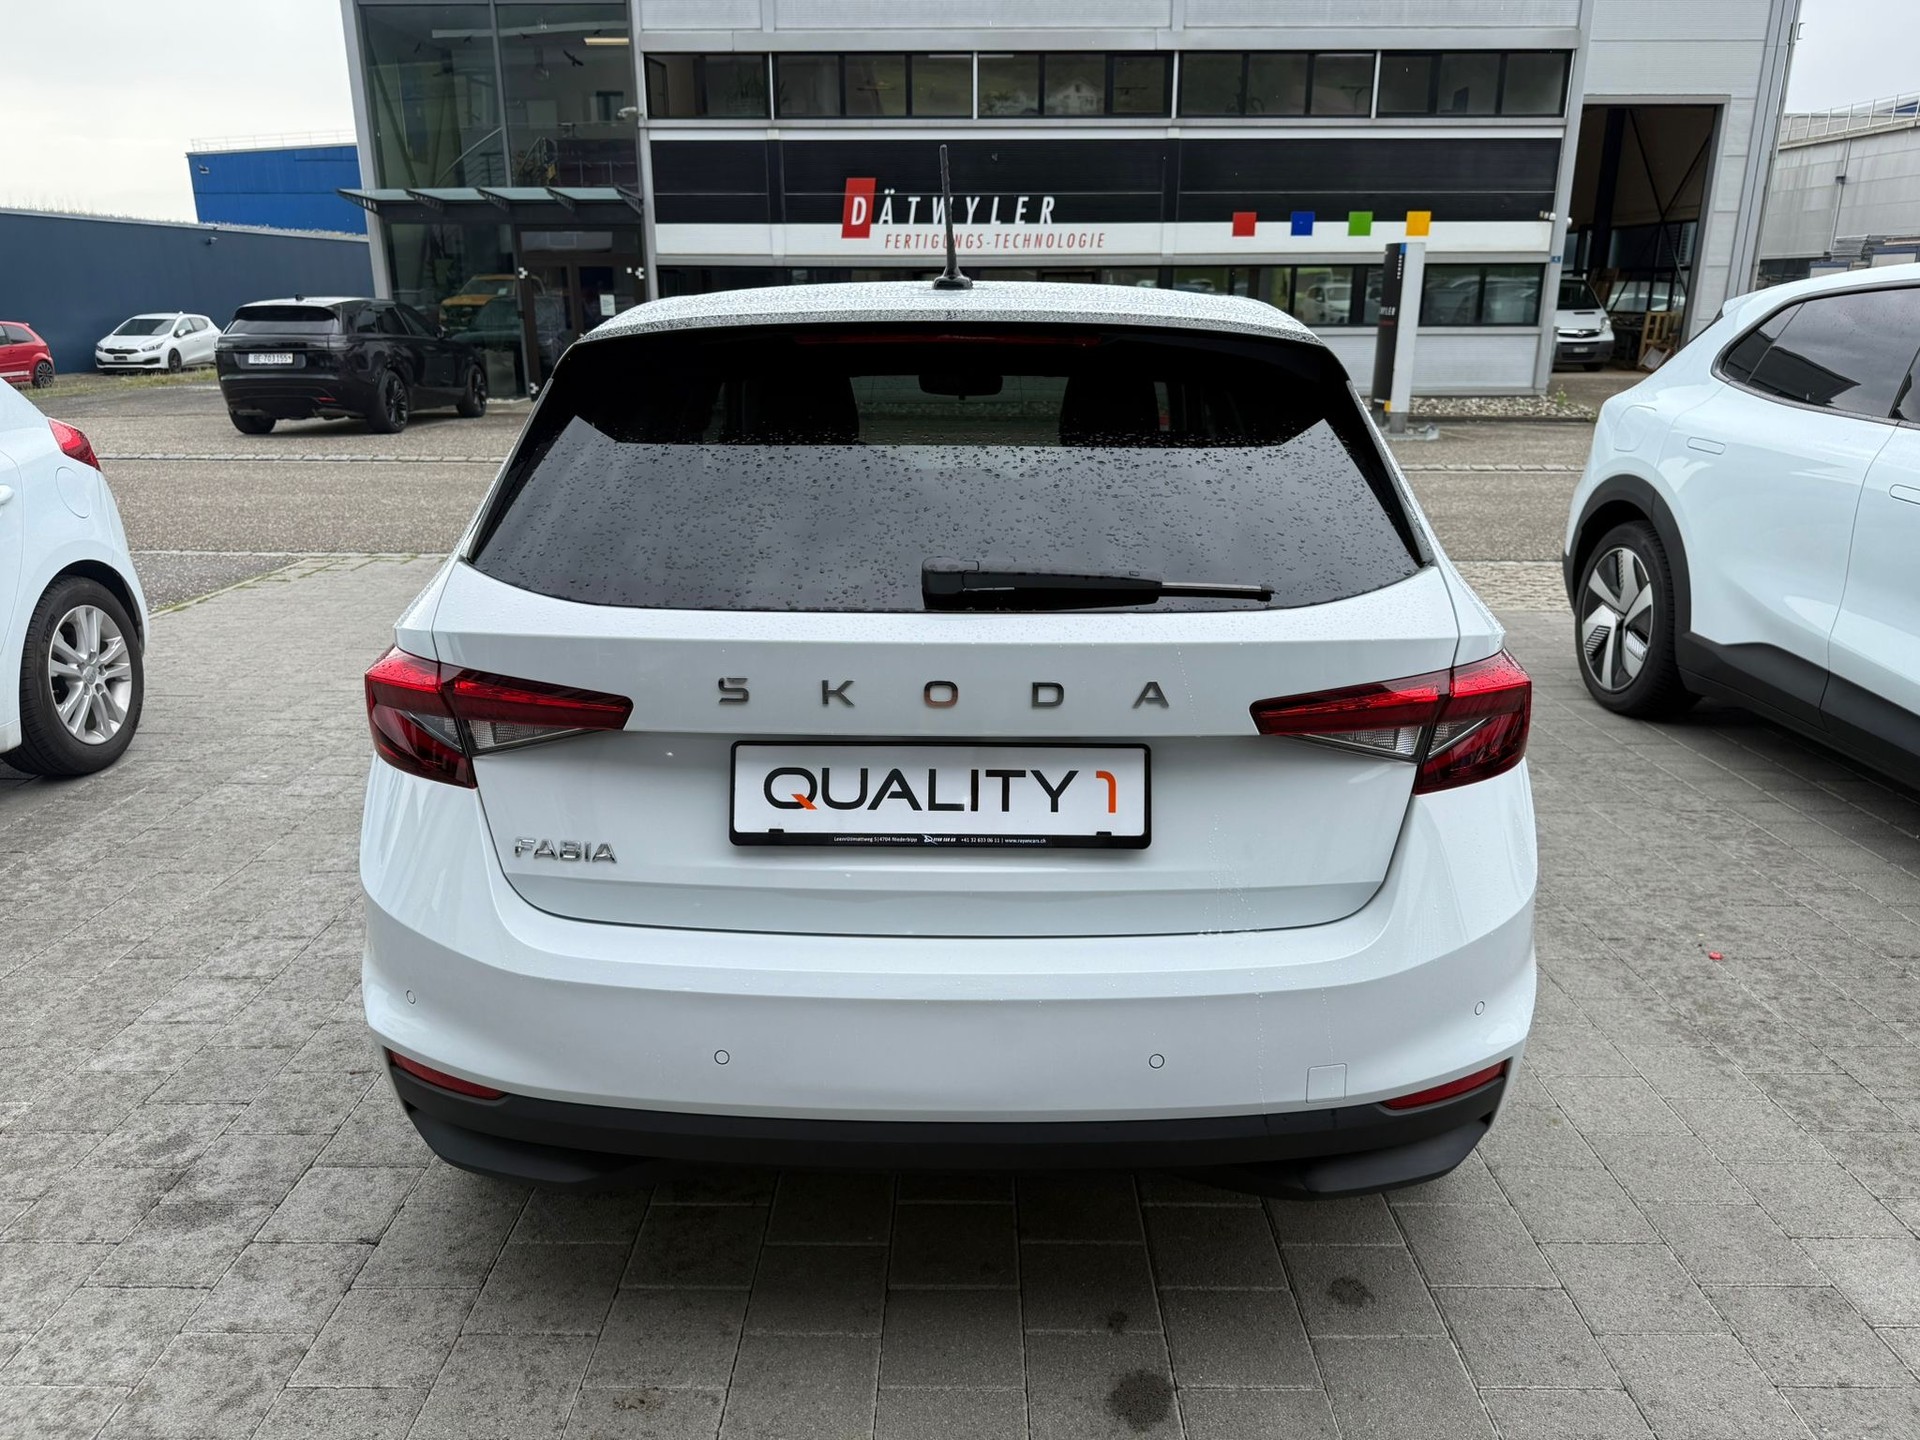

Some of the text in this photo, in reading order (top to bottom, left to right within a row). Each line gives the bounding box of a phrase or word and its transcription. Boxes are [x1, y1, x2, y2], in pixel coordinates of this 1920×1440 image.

[851, 188, 1056, 226] DÄTWYLER
[763, 767, 1117, 814] QUALITY 1
[514, 838, 617, 863] FABIA
